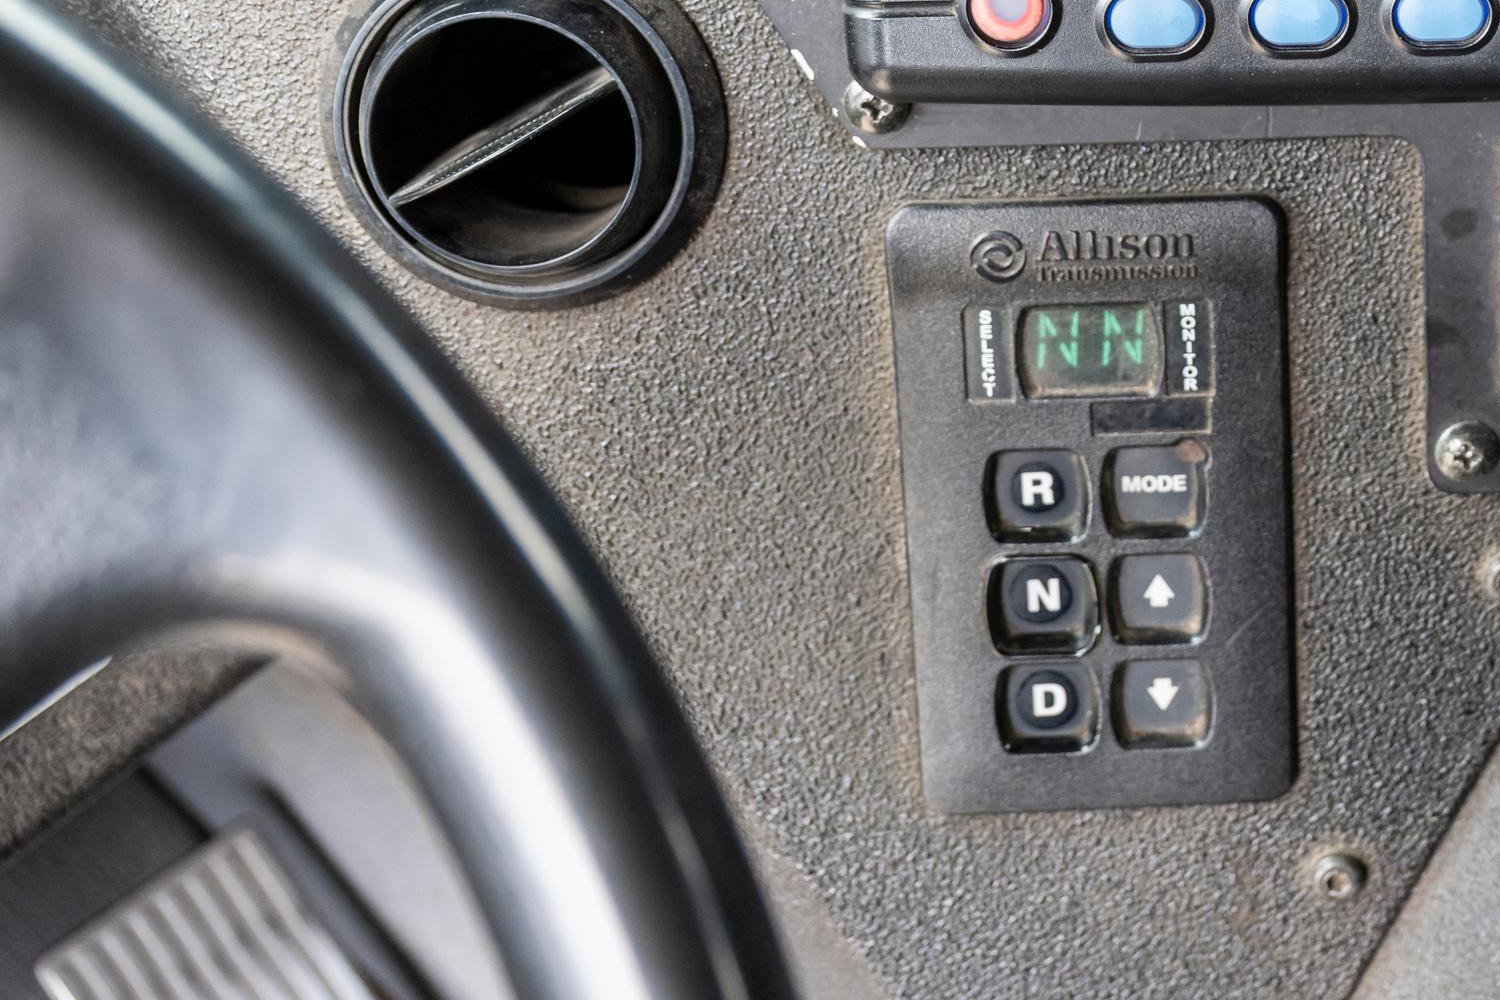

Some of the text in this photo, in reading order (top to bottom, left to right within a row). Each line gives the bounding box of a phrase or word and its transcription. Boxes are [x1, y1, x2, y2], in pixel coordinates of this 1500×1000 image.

[1037, 229, 1198, 263] Allison
[1036, 263, 1199, 283] Transmission
[978, 309, 996, 398] SELECT
[1178, 303, 1199, 392] MONITOR
[1019, 471, 1056, 507] R
[1120, 473, 1188, 493] MODE
[1025, 577, 1061, 613] N
[1031, 681, 1068, 717] D
